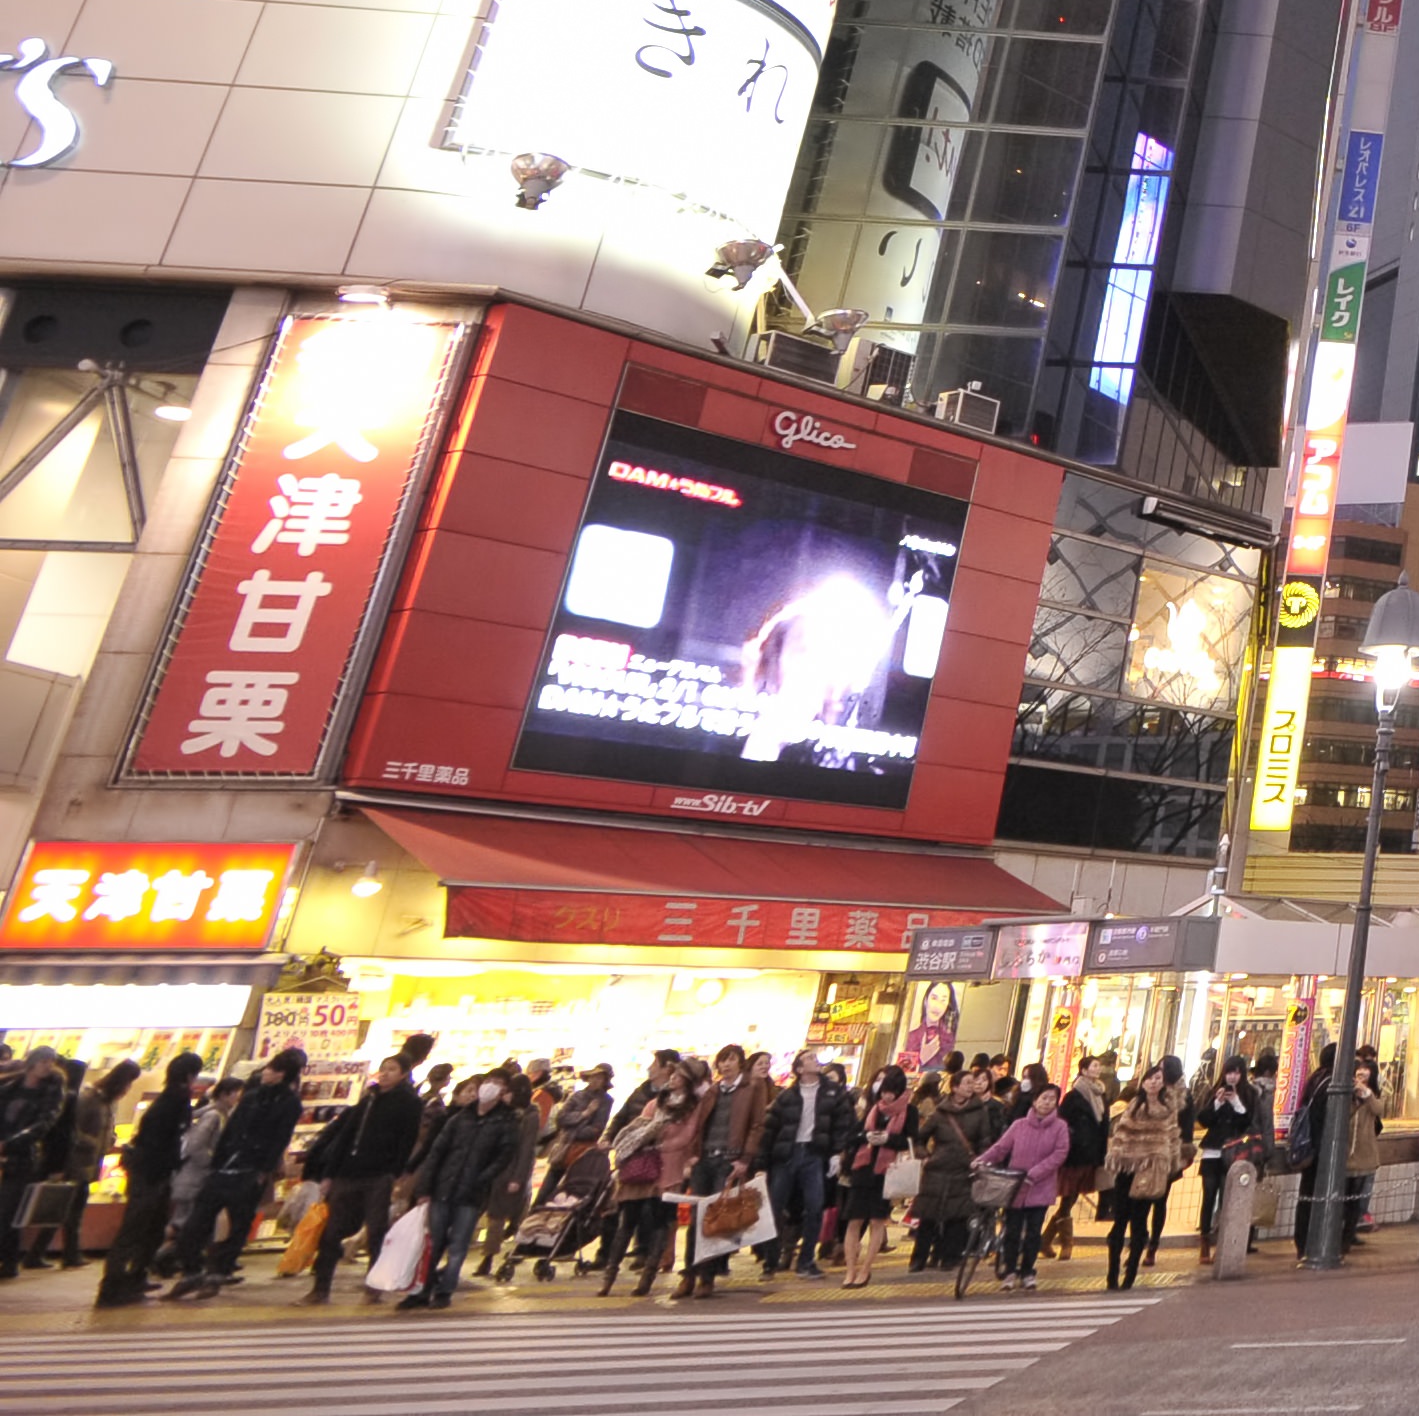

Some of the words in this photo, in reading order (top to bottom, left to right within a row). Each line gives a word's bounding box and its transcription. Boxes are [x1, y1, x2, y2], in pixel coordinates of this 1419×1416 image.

[1347, 137, 1373, 219] レオパレス21
[1345, 223, 1361, 233] 6F
[1330, 278, 1355, 328] レイク
[775, 410, 857, 449] Glico
[1299, 438, 1337, 515] アコム
[382, 761, 470, 786] 三千里薬品
[1262, 710, 1296, 803] プロミス
[555, 905, 621, 930] クスリ
[312, 1004, 346, 1027] 50
